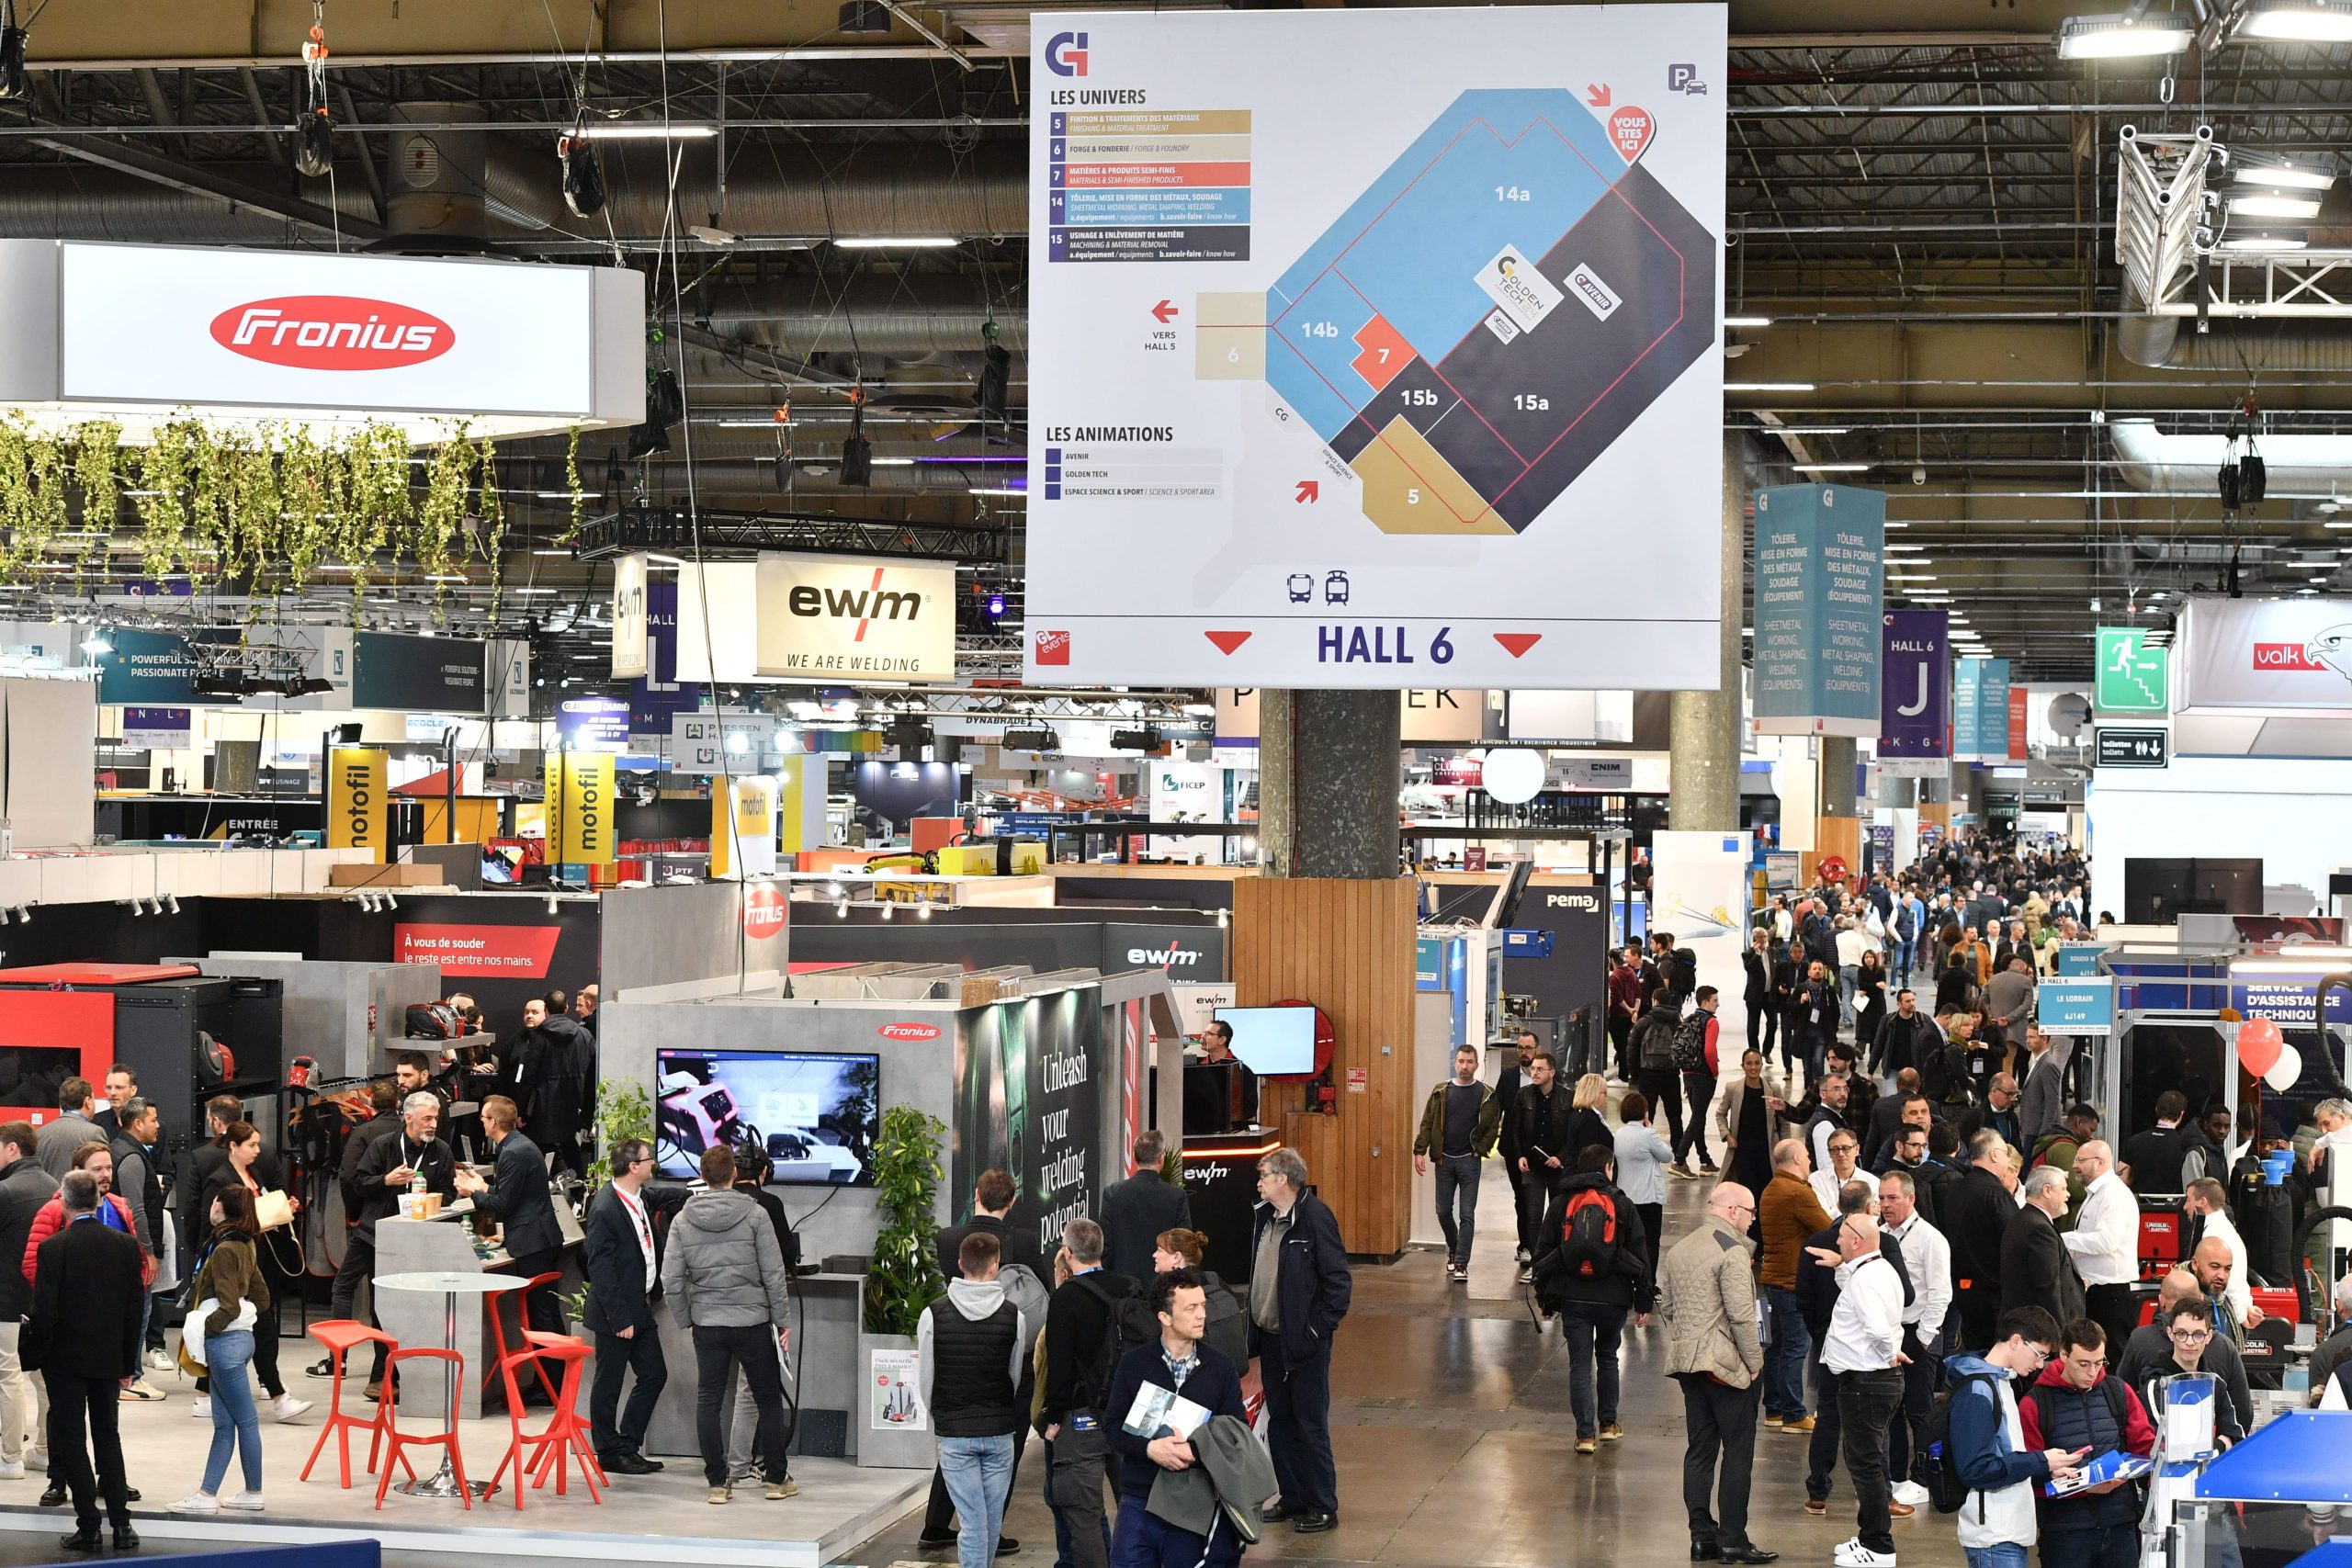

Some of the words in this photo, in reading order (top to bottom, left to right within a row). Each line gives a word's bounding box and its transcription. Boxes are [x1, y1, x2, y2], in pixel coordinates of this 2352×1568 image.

[1050, 90, 1076, 106] LES
[1080, 89, 1147, 105] UNIVERS
[1105, 114, 1148, 122] TRAITEMENTS
[1149, 114, 1162, 122] DES
[1162, 112, 1200, 121] MATÉRIAUX
[1613, 117, 1646, 128] VOUS
[1069, 124, 1101, 132] FINISHING
[1106, 124, 1136, 132] MATERIAL
[1136, 123, 1170, 131] TREATMENT
[1617, 127, 1643, 140] ÊTES
[1160, 144, 1190, 152] FOUNDRY
[1622, 140, 1638, 150] ICI
[1069, 165, 1101, 175] MATIÈRES
[1107, 166, 1140, 175] PRODUITS
[1141, 166, 1176, 175] SEMI-FINIS
[1069, 176, 1102, 185] MATERIALS
[1106, 176, 1152, 185] SEMI-FINISHED
[1152, 175, 1184, 184] PRODUCTS
[1070, 193, 1099, 202] TÔLERIE,
[1149, 193, 1162, 201] DES
[1162, 192, 1192, 202] MÉTAUX,
[1192, 193, 1224, 201] SOUDAGE
[1495, 185, 1532, 204] 14a
[1051, 197, 1063, 208] 14
[1069, 204, 1106, 212] SHEETMETAL
[1119, 214, 1155, 222] equipments
[1223, 212, 1237, 220] how
[1051, 234, 1063, 244] 15
[1069, 231, 1098, 240] USINAGE
[1098, 231, 1104, 240] &
[1104, 230, 1147, 239] ENLÈVEMENT
[1147, 231, 1157, 239] DE
[1157, 229, 1185, 239] MATIÈRE
[1069, 241, 1105, 249] MACHINING
[1111, 241, 1140, 249] MATERIAL
[1118, 251, 1154, 259] equipments
[1205, 250, 1223, 258] know
[1222, 250, 1237, 258] how
[1498, 277, 1525, 305] TECH
[1582, 283, 1611, 310] AVENIR
[232, 308, 438, 353] Fronius
[1301, 321, 1339, 338] 14b
[1152, 331, 1176, 340] VERS
[1144, 342, 1169, 351] HALL
[1170, 342, 1176, 351] 5
[1227, 347, 1239, 363] 6
[1378, 348, 1390, 364] 7
[1400, 388, 1439, 406] 15b
[1513, 393, 1550, 412] 15a
[1275, 407, 1289, 422] CG
[1046, 427, 1071, 442] LES
[1075, 426, 1173, 442] ANIMATIONS
[1065, 470, 1091, 479] GOLDEN
[1092, 470, 1108, 479] TECH
[1065, 488, 1088, 496] ESPACE
[1089, 488, 1115, 496] SCIENCE
[1123, 488, 1144, 496] SPORT
[1148, 488, 1172, 496] SCIENCE
[1180, 488, 1199, 496] SPORT
[1198, 488, 1215, 496] AREA
[1407, 489, 1419, 504] 5
[1760, 550, 1775, 559] MISE
[1776, 549, 1786, 559] EN
[1786, 547, 1808, 558] FORME
[1825, 547, 1841, 558] MISE
[1842, 548, 1852, 559] EN
[1853, 550, 1877, 562] FORME
[1763, 564, 1775, 574] DES
[1827, 561, 1840, 573] DES
[1841, 560, 1871, 577] MÉTAUX,
[1769, 577, 1799, 588] SOUDAGE
[1834, 577, 1867, 590] SOUDAGE
[1042, 631, 1070, 654] events
[1318, 626, 1414, 664] HALL
[1430, 626, 1454, 664] 6
[1891, 640, 1924, 651] HALL
[1927, 640, 1934, 651] 6
[131, 655, 183, 665] POWERFUL
[1822, 649, 1844, 660] METAL
[2257, 646, 2300, 665] valk
[647, 636, 680, 692] L
[787, 653, 809, 668] WE
[815, 655, 844, 670] ARE
[850, 656, 920, 672] WELDING
[130, 668, 187, 678] PASSIONATE
[1769, 664, 1796, 675] WELDING
[1833, 665, 1863, 677] WELDING
[1896, 661, 1928, 716] J
[139, 709, 146, 718] N
[167, 709, 174, 718] L
[644, 714, 653, 722] M
[966, 716, 1026, 726] DYNABRADE
[1893, 738, 1901, 747] K
[1922, 738, 1930, 747] G
[2102, 740, 2132, 749] toilettes
[2102, 748, 2125, 756] toilets
[1042, 754, 1065, 763] ECM
[1181, 782, 1205, 790] FICEP
[578, 768, 598, 851] motofil
[741, 793, 766, 817] motofil
[229, 818, 278, 829] ENTRÉE
[404, 932, 412, 947] À
[413, 938, 436, 948] vous
[438, 936, 450, 949] de
[452, 938, 485, 949] souder
[404, 952, 413, 964] le
[414, 953, 439, 964] reste
[441, 953, 456, 964] est
[458, 954, 482, 965] entre
[484, 956, 502, 965] nos
[503, 955, 535, 966] mains.
[2064, 1012, 2086, 1021] 6J149
[883, 1025, 937, 1037] Fronius
[1043, 1045, 1088, 1094] Unleash
[1041, 1108, 1069, 1154] your
[1041, 1146, 1086, 1195] welding
